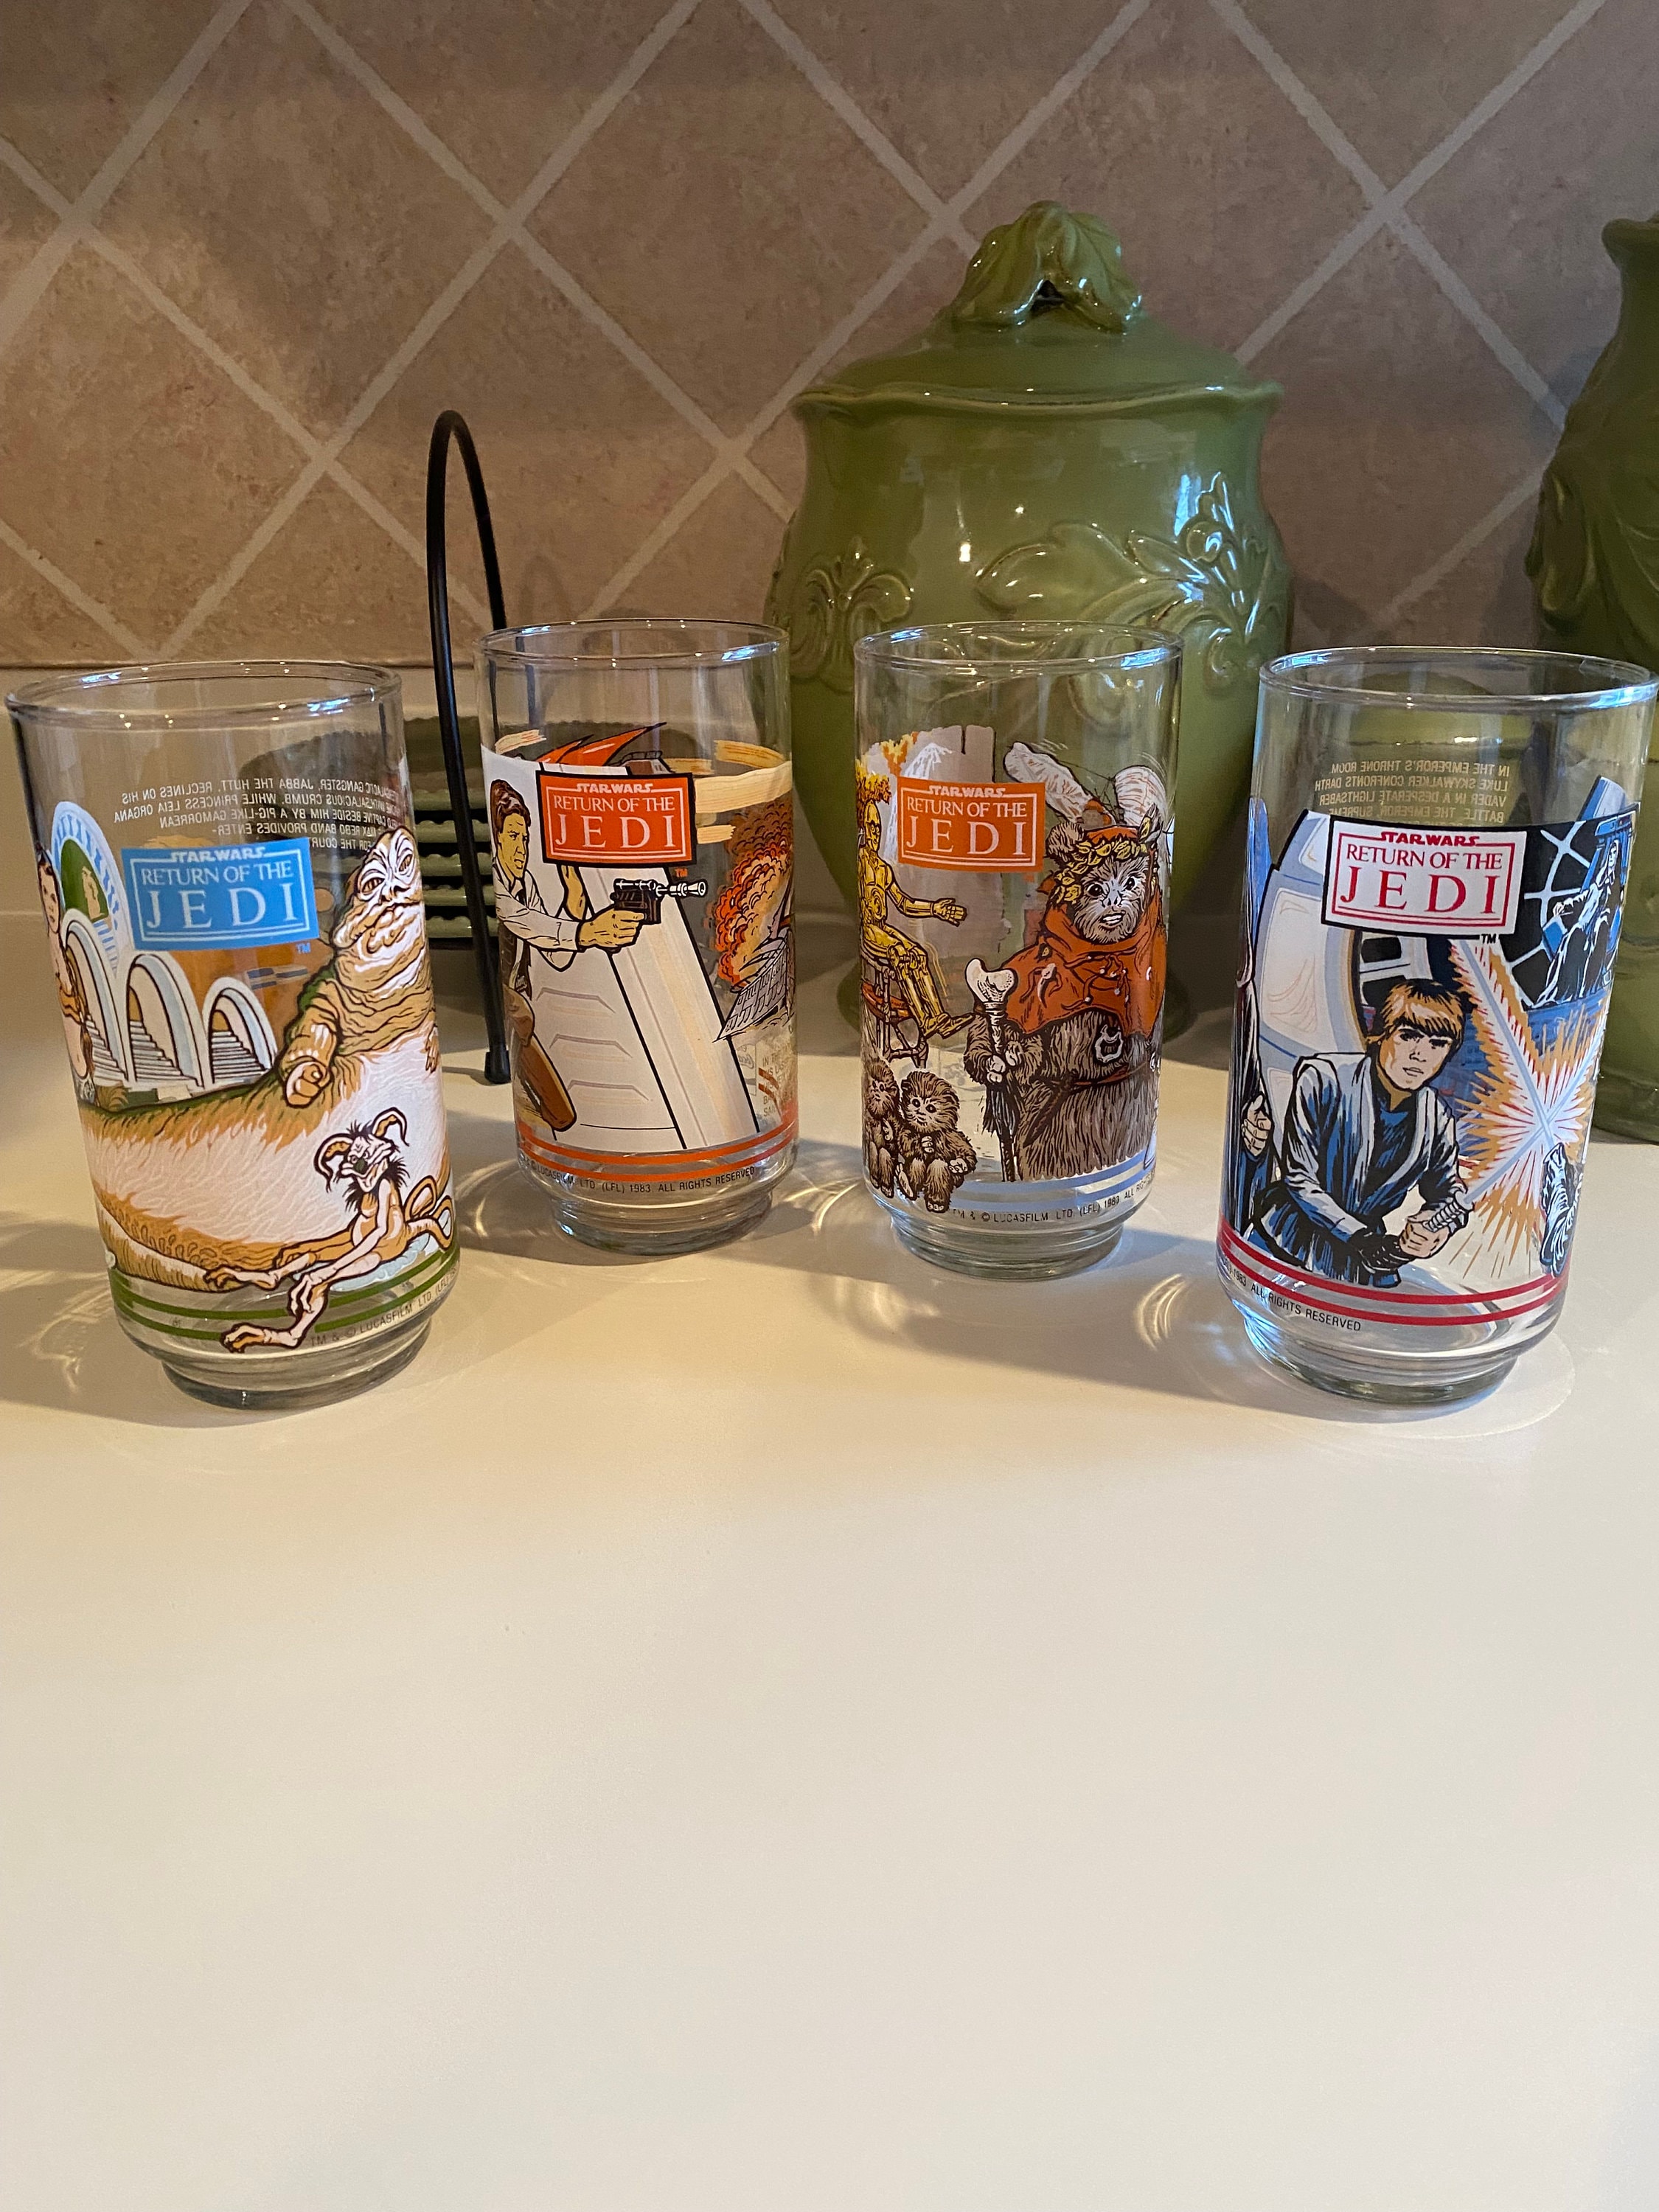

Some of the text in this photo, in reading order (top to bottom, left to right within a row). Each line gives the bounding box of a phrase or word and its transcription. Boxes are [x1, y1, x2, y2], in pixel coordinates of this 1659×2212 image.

[577, 783, 653, 793] STAR WARS
[928, 785, 1006, 798] STAR WARS
[553, 795, 675, 812] RETURN OF THE
[907, 796, 1027, 817] RETURN OF THE
[555, 813, 676, 849] JEDI
[905, 815, 1027, 855] JEDI
[1380, 831, 1480, 846] STAR WARS
[171, 847, 265, 863] STAR WARS
[1346, 844, 1503, 869] RETURN OF THE
[141, 860, 294, 886] RETURN OF THE
[1340, 865, 1500, 914] JEDI
[147, 883, 298, 928] JEDI
[296, 942, 311, 954] TM
[1481, 933, 1497, 944] TM
[602, 1182, 625, 1194] (LFL)
[658, 1183, 675, 1192] ALL
[679, 1178, 712, 1191] RIGHTS
[715, 1166, 755, 1185] RESERVED
[1079, 1203, 1100, 1217] (LFL)
[1124, 1188, 1134, 1199] ALL
[1251, 1284, 1265, 1300] ALL
[1268, 1292, 1301, 1315] RIGHTS
[1305, 1308, 1362, 1332] RESERVED
